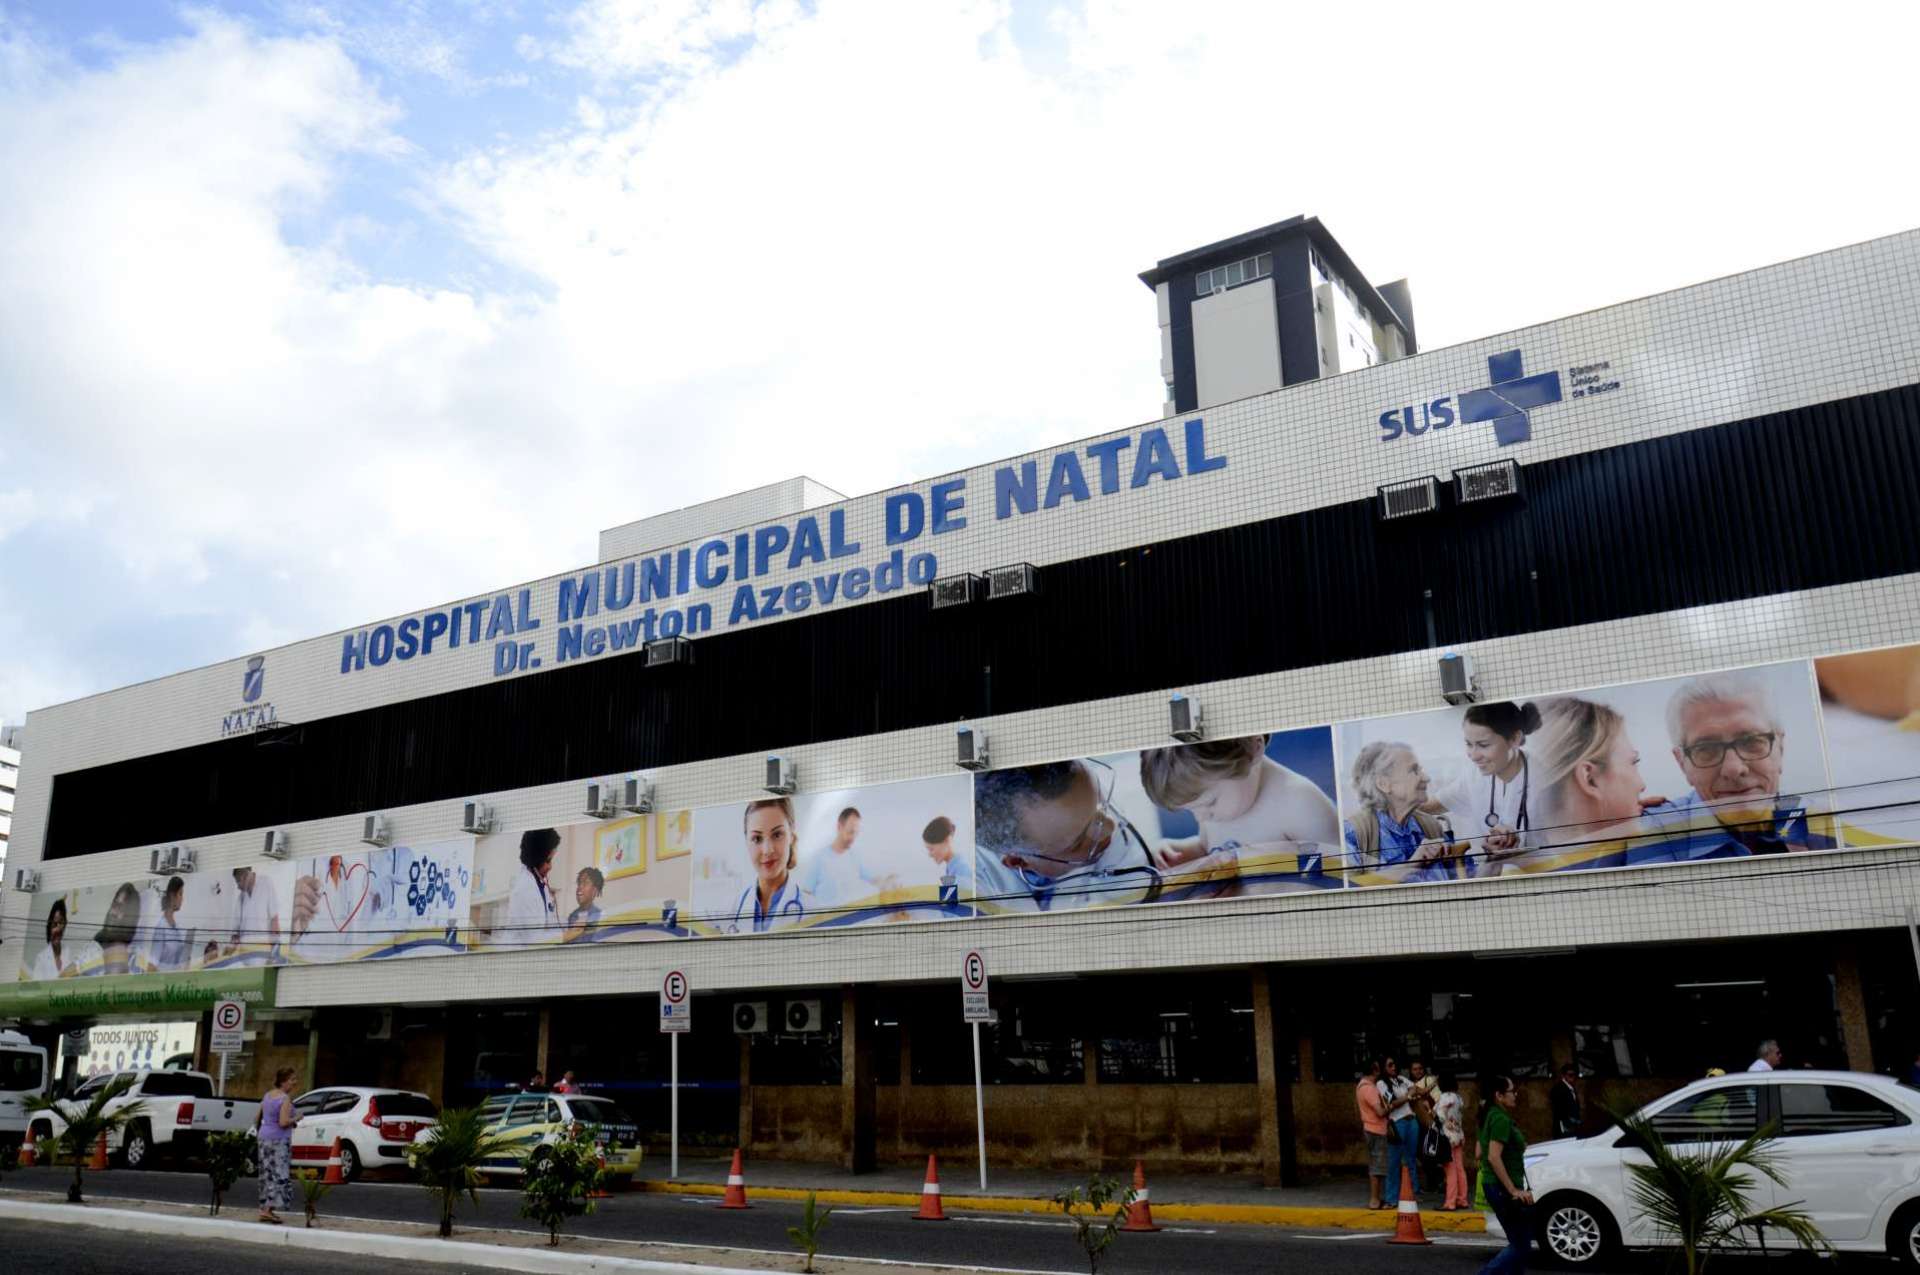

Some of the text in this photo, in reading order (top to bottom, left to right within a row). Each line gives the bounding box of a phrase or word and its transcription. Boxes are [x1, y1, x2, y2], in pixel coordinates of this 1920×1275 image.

[1379, 397, 1455, 442] SUS
[341, 417, 1228, 674] HOSPITAL MUNICIPAL DE NATAL
[493, 548, 939, 677] Dr. Newton Azevedo
[222, 706, 277, 732] NATAL
[971, 959, 980, 982] E
[671, 977, 681, 997] E
[224, 1008, 234, 1025] E
[92, 1031, 122, 1045] TODOS
[123, 1030, 159, 1044] JUNTOS
